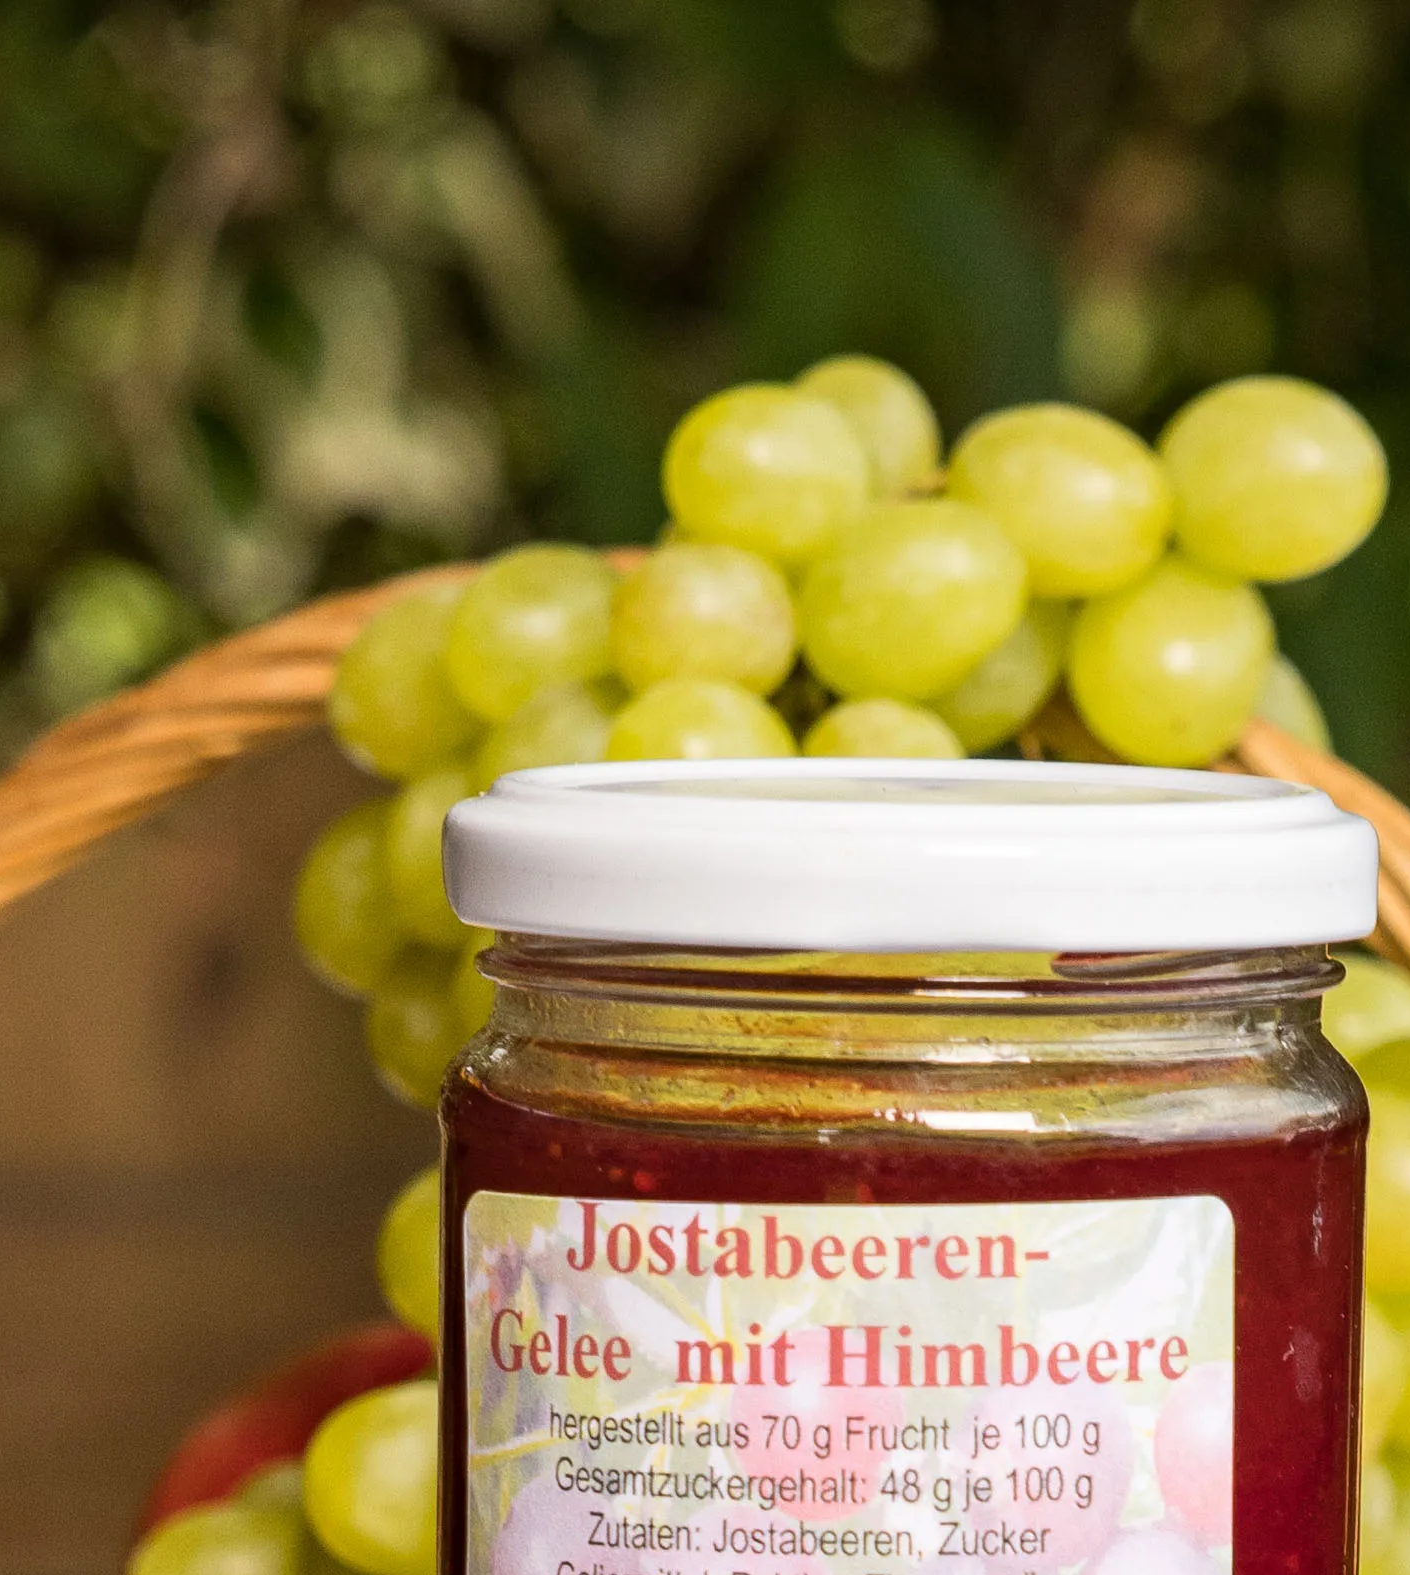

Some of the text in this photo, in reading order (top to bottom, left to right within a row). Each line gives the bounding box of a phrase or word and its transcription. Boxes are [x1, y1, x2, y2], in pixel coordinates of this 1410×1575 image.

[565, 1201, 1052, 1281] Jostabeeren-
[490, 1307, 1191, 1387] Gelee mit Himbeere
[587, 1510, 1049, 1563] Zutaten: Jostabeeren, Zucker
